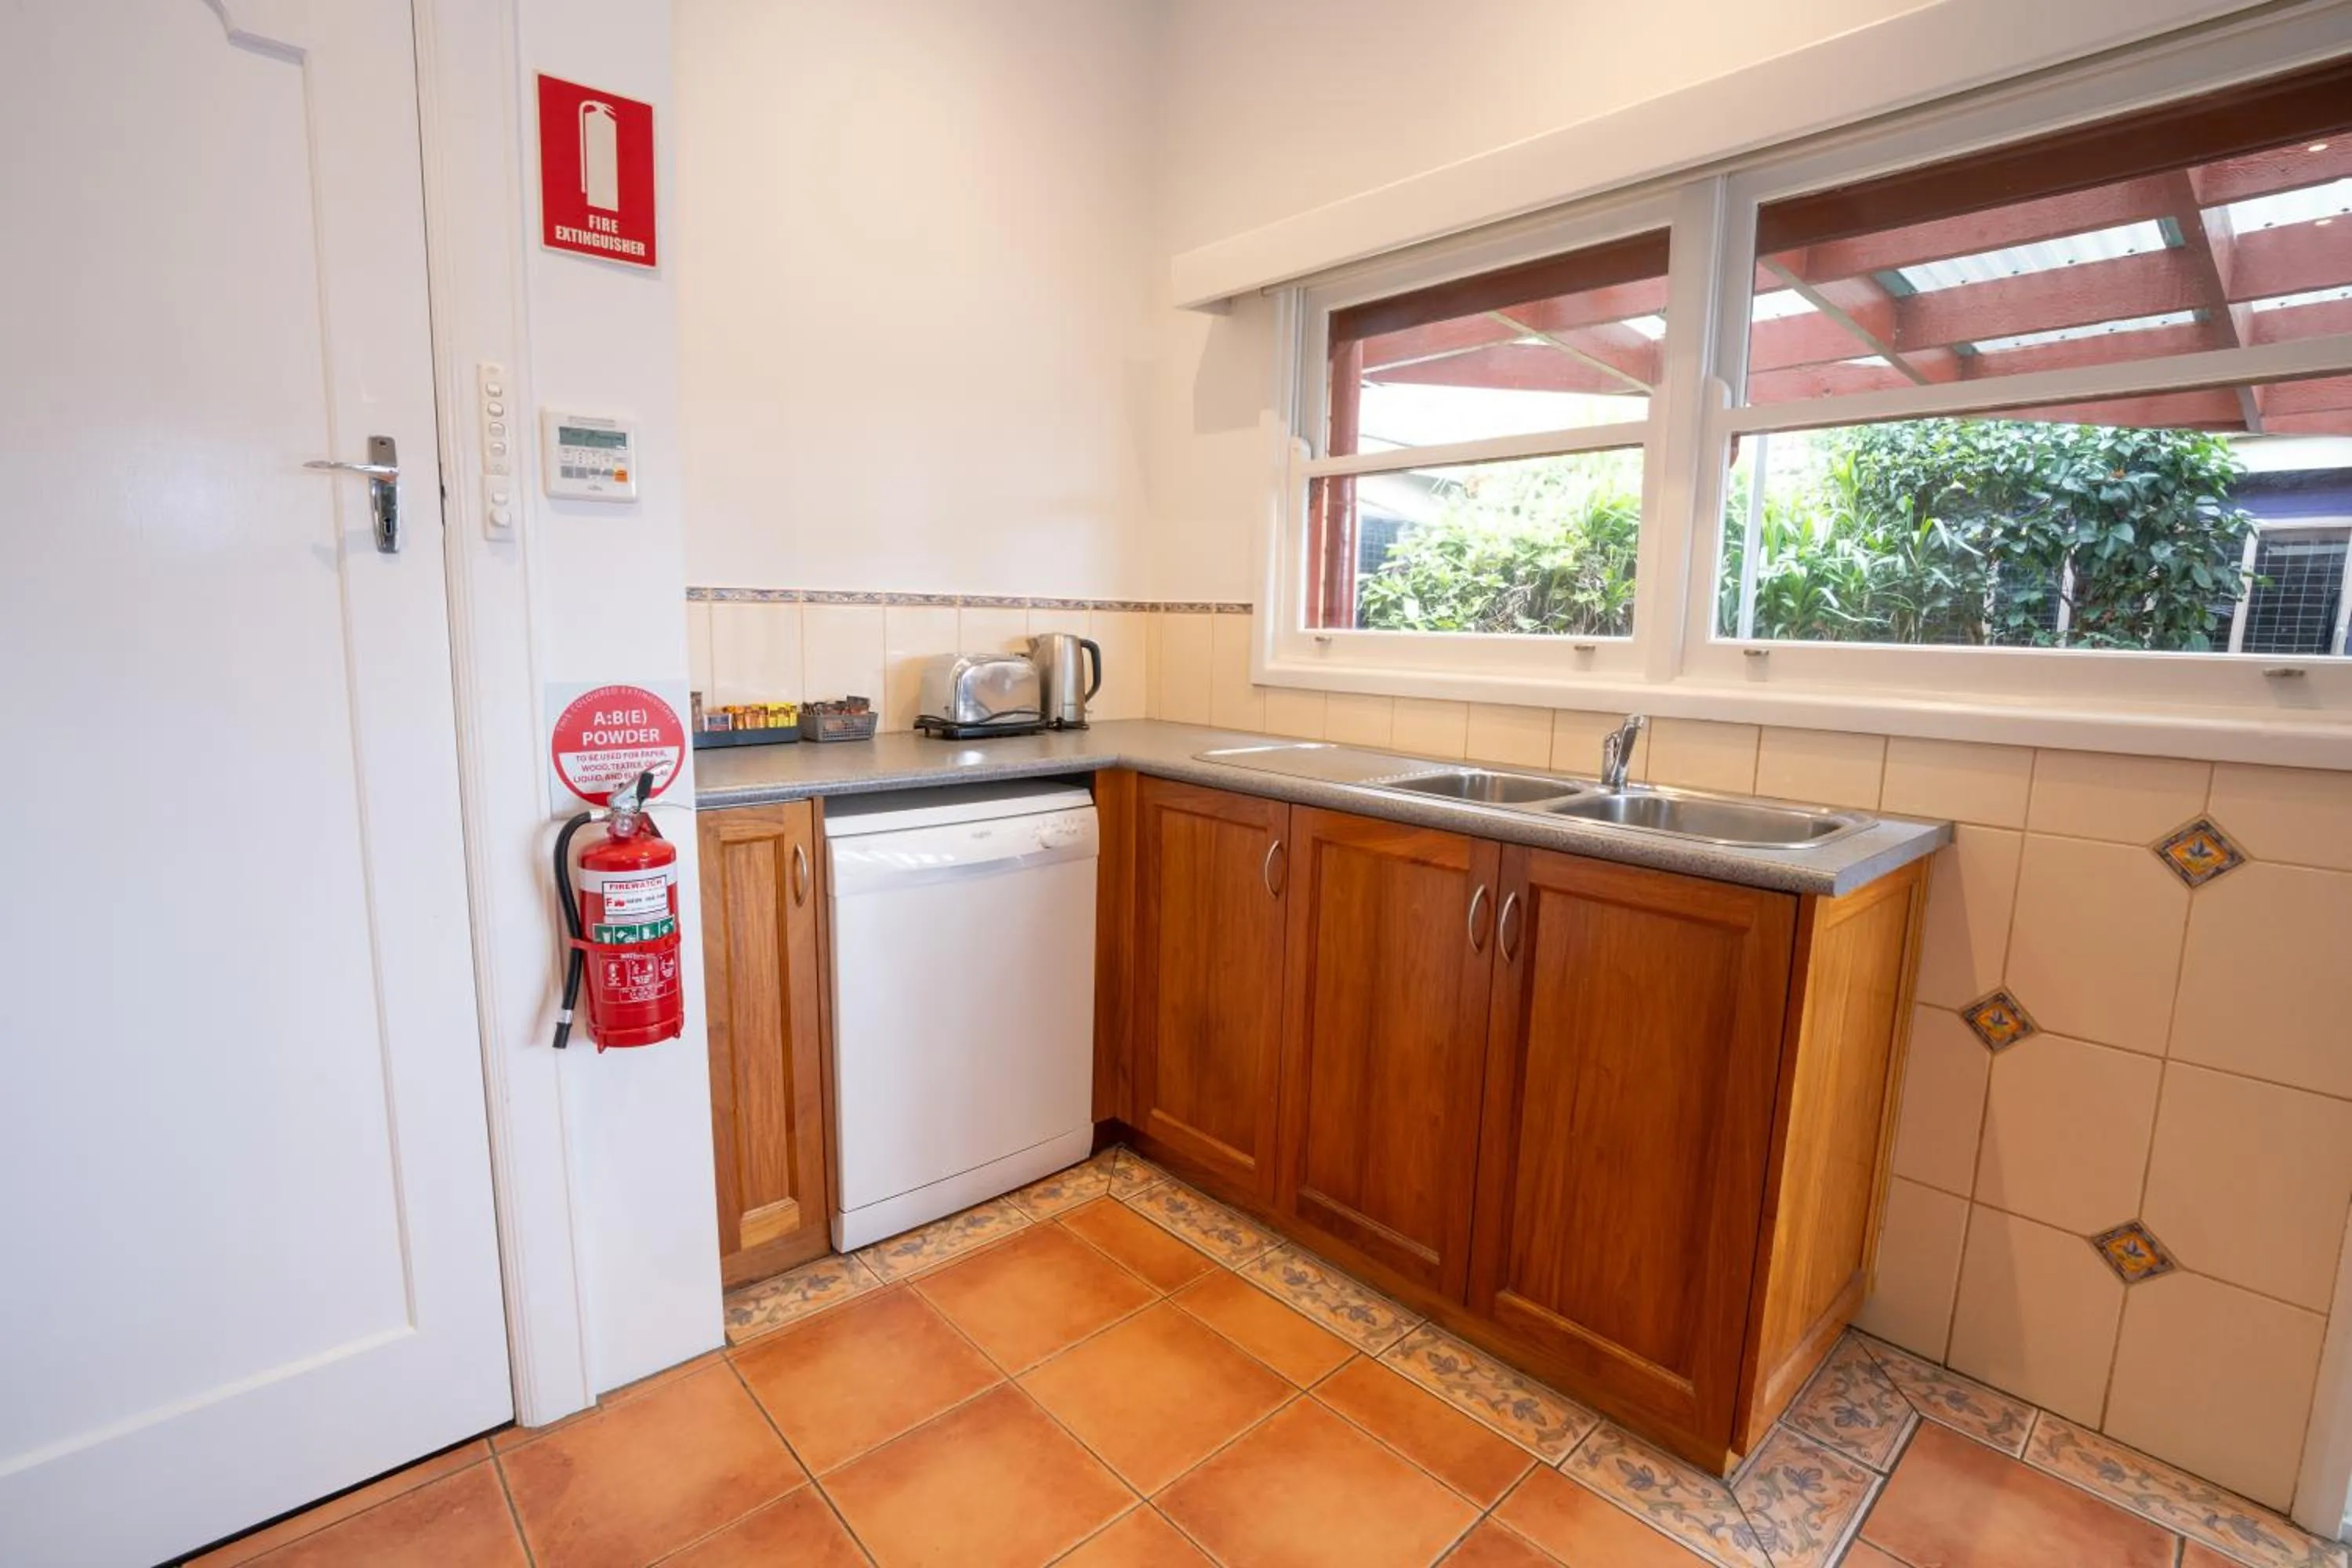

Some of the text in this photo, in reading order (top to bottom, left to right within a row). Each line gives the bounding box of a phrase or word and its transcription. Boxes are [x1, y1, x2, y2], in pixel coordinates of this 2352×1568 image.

[589, 214, 619, 234] FIRE
[555, 225, 645, 256] EXTINGUISHER
[593, 709, 648, 725] A:B(E)
[583, 728, 659, 746] POWDER
[601, 752, 622, 760] USED
[609, 880, 662, 890] FIREWATCH
